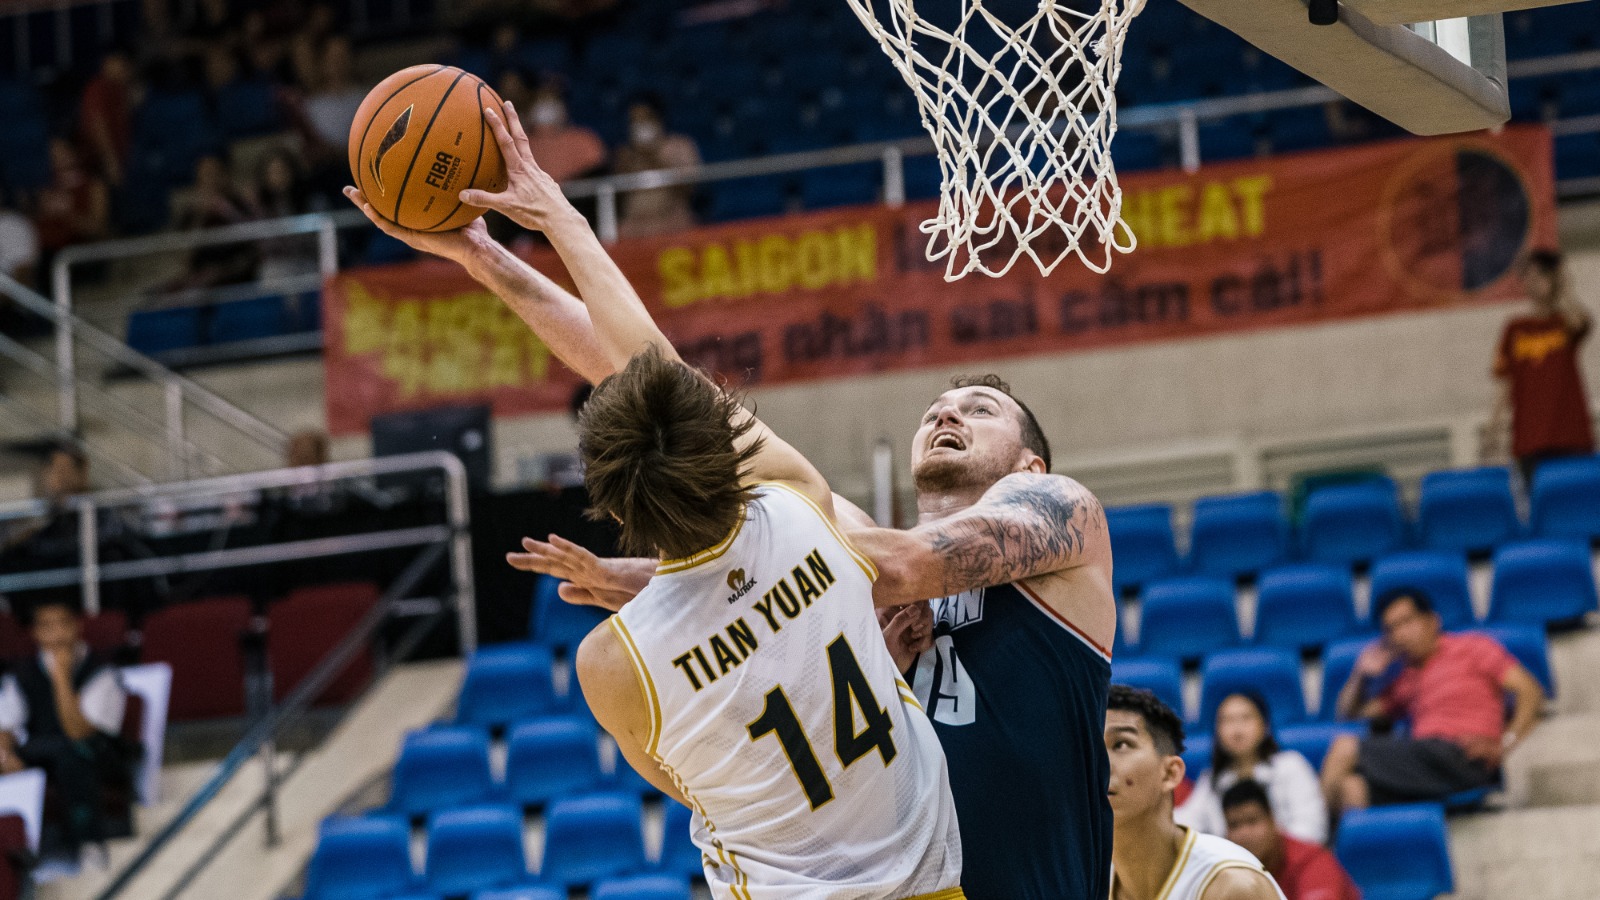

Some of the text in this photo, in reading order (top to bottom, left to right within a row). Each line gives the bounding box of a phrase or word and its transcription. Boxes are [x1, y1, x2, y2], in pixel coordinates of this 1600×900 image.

[425, 151, 453, 189] FIBA
[656, 223, 878, 308] SAIGON
[1117, 175, 1274, 250] HEAT
[672, 617, 759, 692] TIAN
[752, 548, 837, 634] YUAN
[728, 577, 757, 604] MATRIX
[745, 632, 897, 812] 14
